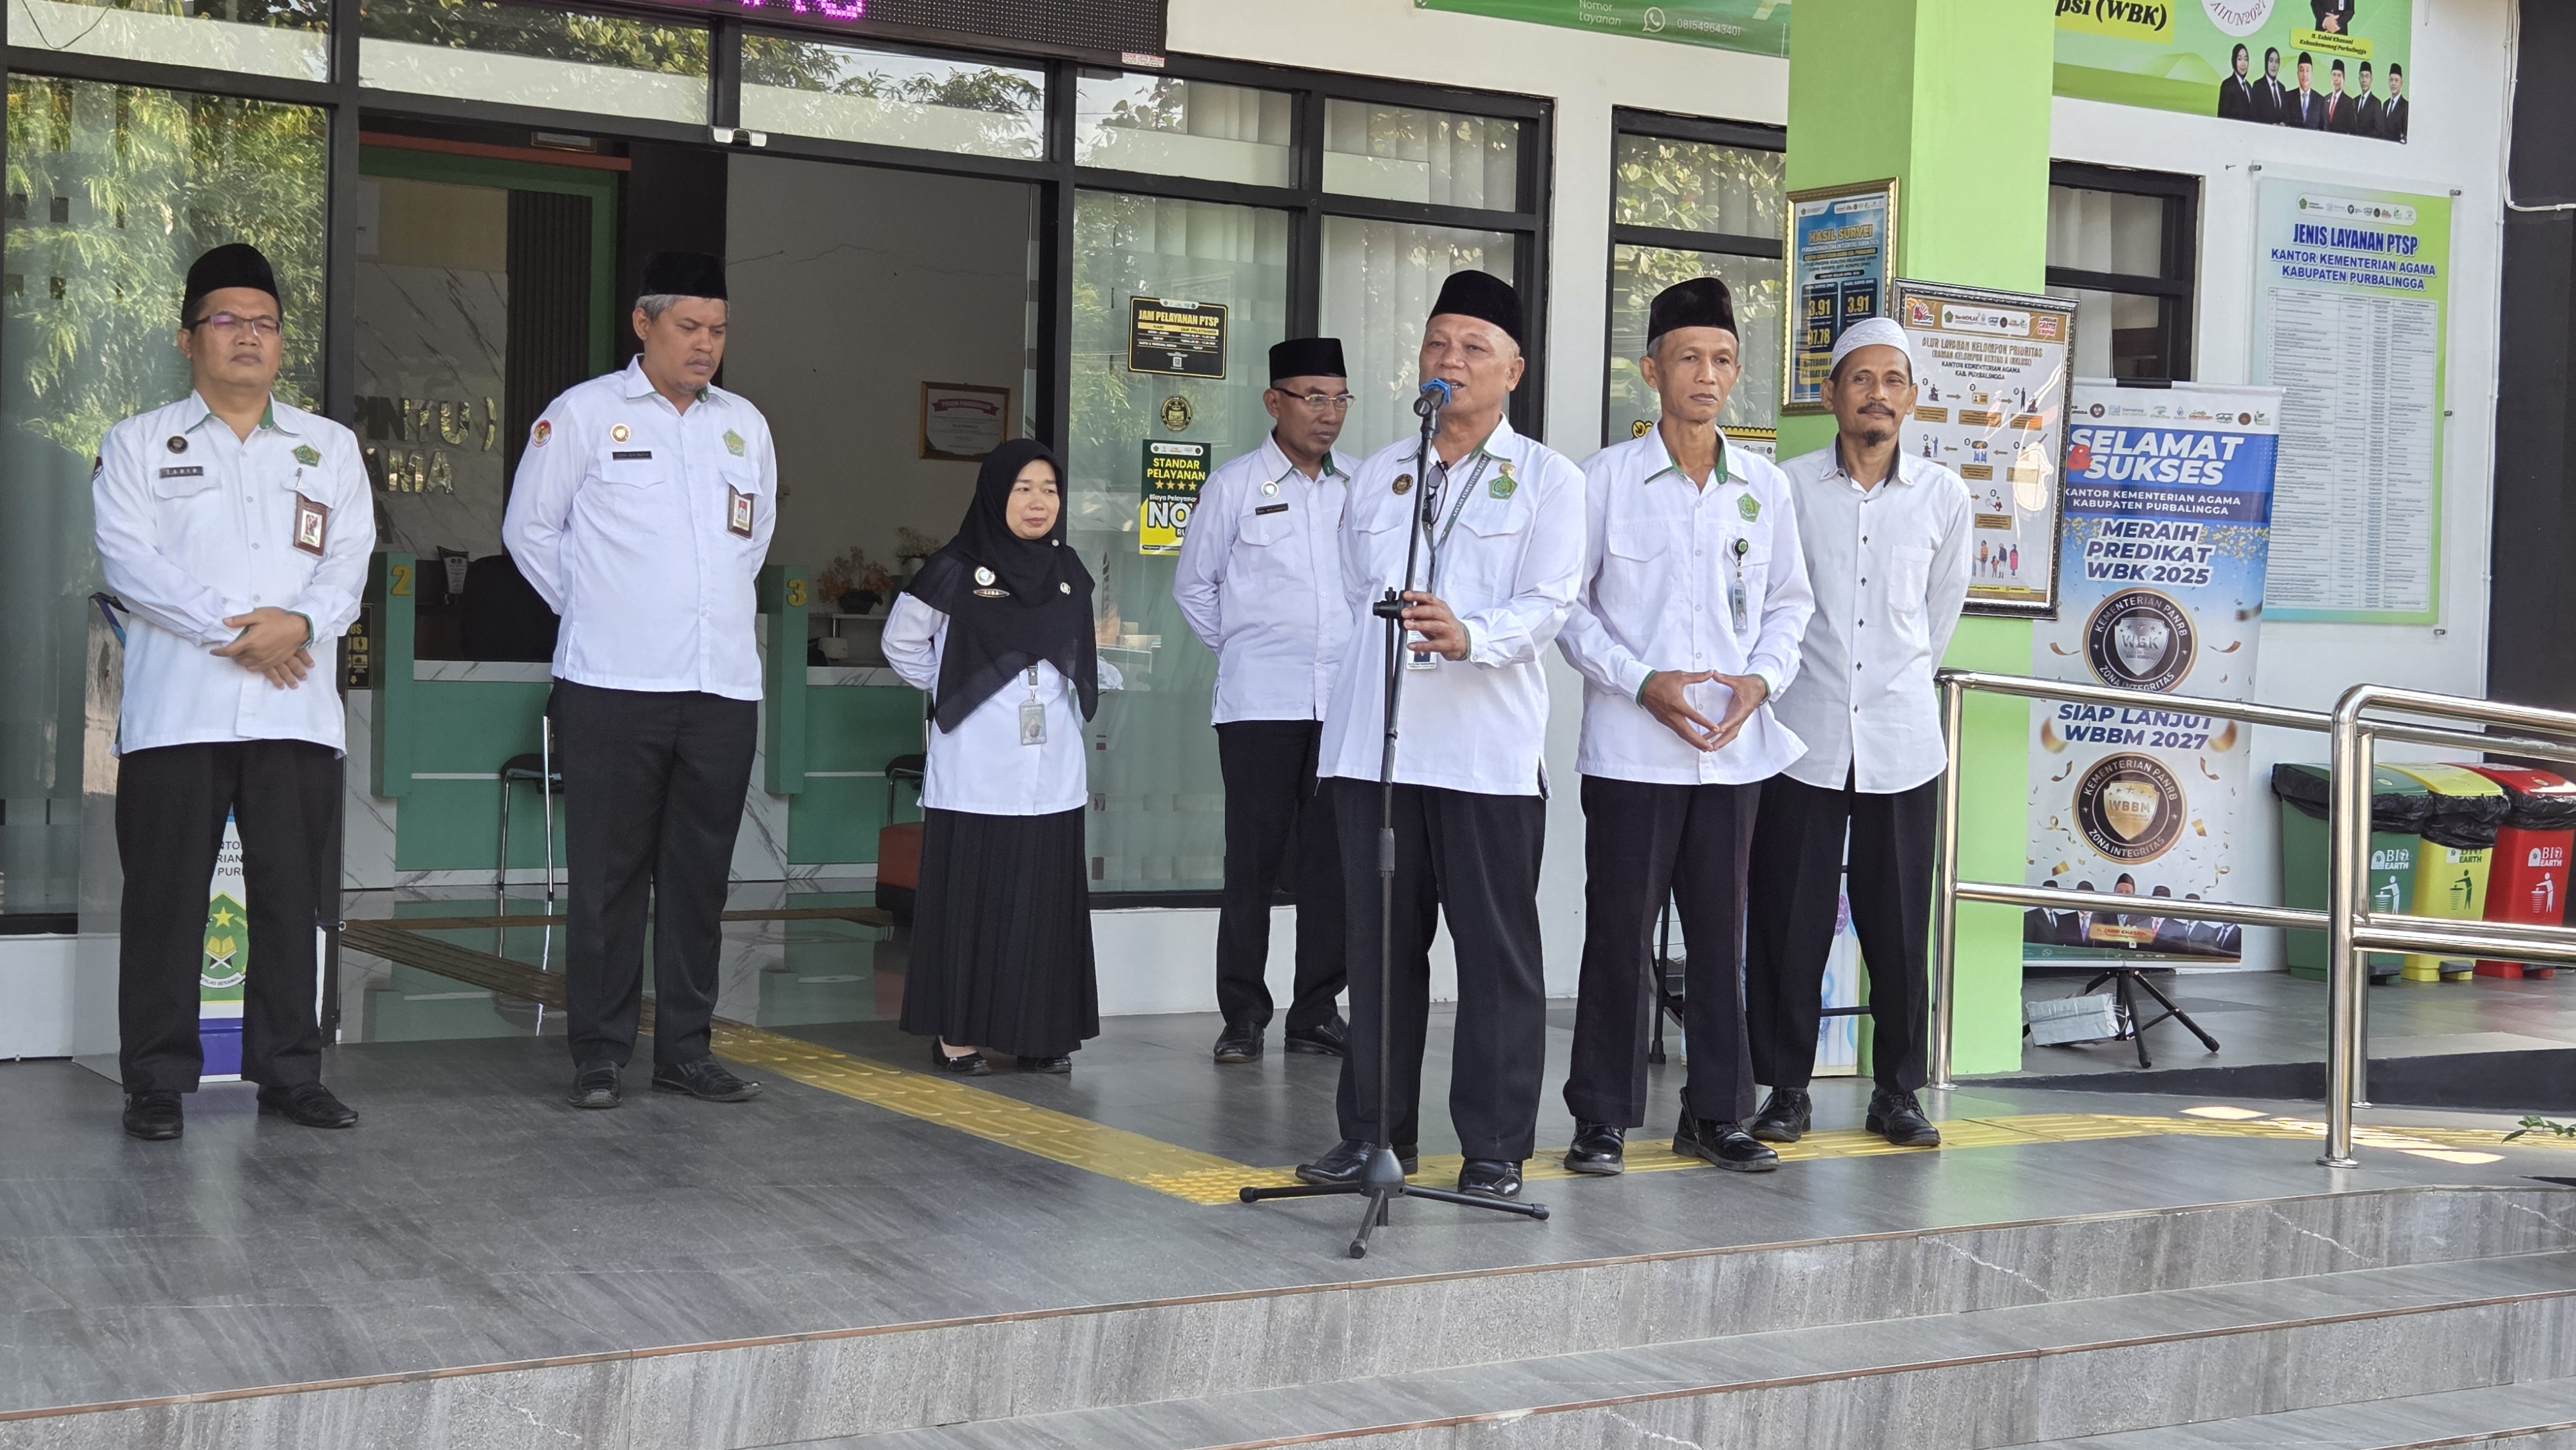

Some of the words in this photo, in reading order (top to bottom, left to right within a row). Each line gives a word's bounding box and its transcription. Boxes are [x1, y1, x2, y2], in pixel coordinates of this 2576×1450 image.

[1579, 0, 1613, 12] Nomor
[2096, 0, 2167, 32] (WBK)
[1578, 12, 1621, 26] Layanan
[1677, 18, 1740, 37] 081549643401
[1808, 229, 1836, 243] HASIL
[1838, 224, 1873, 240] SURVEI
[2293, 223, 2327, 246] JENIS
[2331, 227, 2383, 252] LAYANAN
[2387, 234, 2418, 256] PTSP
[2271, 249, 2316, 263] KANTOR
[2320, 253, 2396, 271] KEMENTERIAN
[2399, 262, 2436, 276] AGAMA
[2282, 265, 2346, 282] KABUPATEN
[2349, 272, 2425, 290] PURBALINGGA
[1808, 299, 1831, 316] 3.91
[1847, 295, 1870, 314] 3.91
[1139, 310, 1155, 321] JAM
[1156, 311, 1198, 325] PELAYANAN
[1199, 315, 1219, 326] PTSP
[1922, 337, 1939, 348] ALUR
[1941, 339, 1969, 352] LAYANAN
[1972, 342, 2007, 355] KELOMPOK
[2009, 345, 2043, 358] PRIORITAS
[2069, 428, 2244, 460] SELAMAT
[1147, 468, 1206, 480] PELAYANAN
[1153, 458, 1200, 469] STANDAR
[2068, 445, 2092, 471] &
[2083, 455, 2225, 485] SUKSES
[2073, 498, 2143, 510] KABUPATEN
[2146, 502, 2229, 515] PURBALINGGA
[2113, 491, 2195, 503] KEMENTERIAN
[2198, 495, 2241, 505] AGAMA
[2101, 521, 2199, 542] MERAIH
[2086, 541, 2213, 563] PREDIKAT
[391, 565, 412, 596] 2
[2087, 561, 2149, 580] WBK
[2152, 565, 2210, 585] 2025
[787, 578, 806, 607] 3
[2095, 596, 2163, 633] KEMENTERIAN
[2163, 604, 2188, 636] PANRB
[2121, 634, 2160, 650] WBK
[2099, 664, 2120, 687] ZONA
[2058, 704, 2115, 722] SIAP
[2121, 708, 2211, 730] LANJUT
[2065, 724, 2146, 746] WBBM
[2150, 731, 2210, 749] 2027
[2083, 760, 2152, 796] KEMENTERIAN
[2152, 768, 2178, 800] PANRB
[2108, 799, 2150, 813] WBBM
[2088, 828, 2111, 851] ZONA
[2110, 836, 2164, 857] INTEGRITAS
[2541, 847, 2562, 859] BIO
[2386, 848, 2409, 862] BIO
[2384, 862, 2409, 870] EARTH
